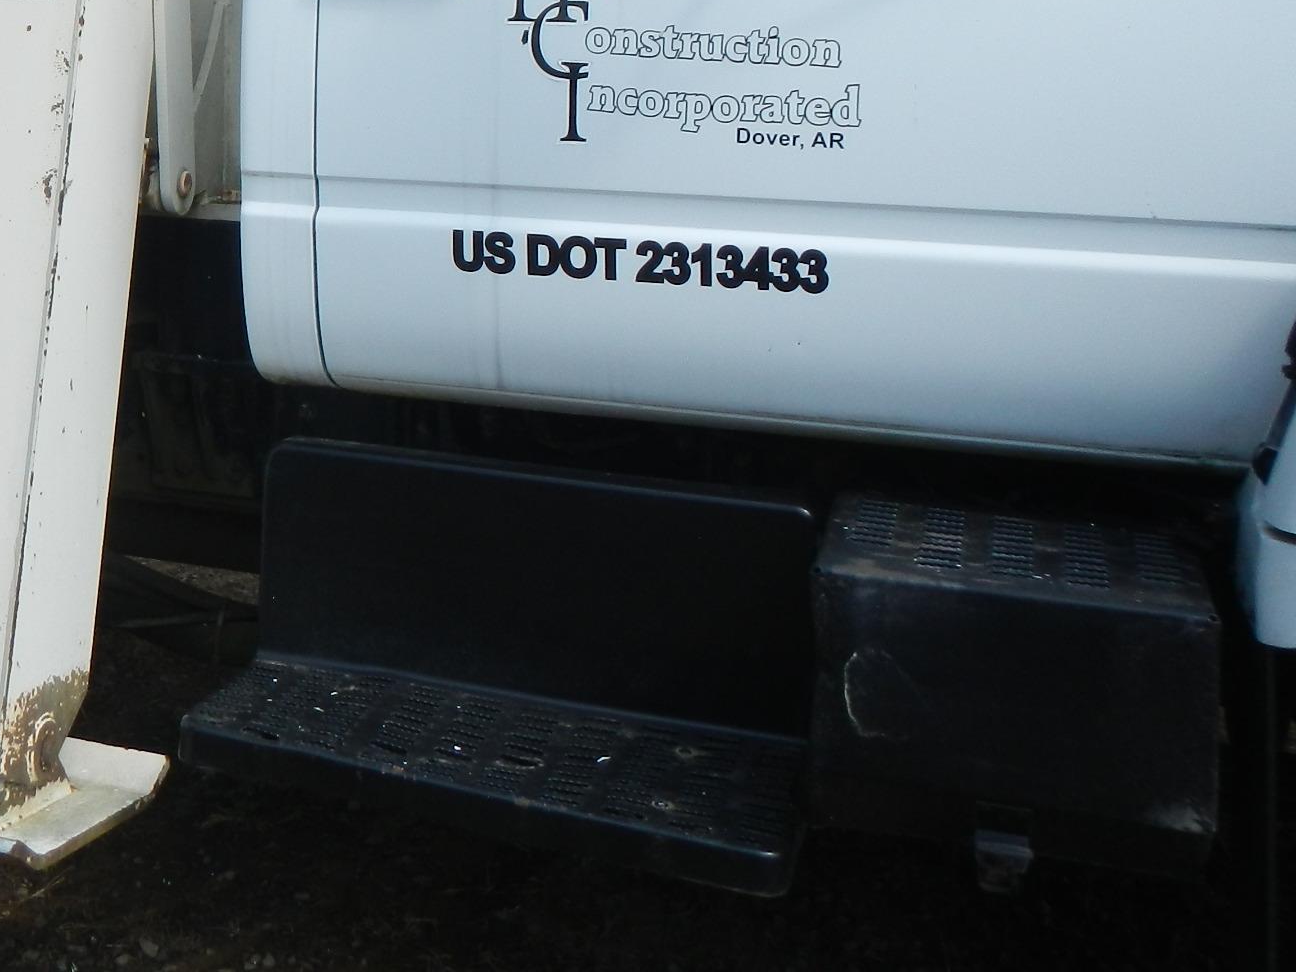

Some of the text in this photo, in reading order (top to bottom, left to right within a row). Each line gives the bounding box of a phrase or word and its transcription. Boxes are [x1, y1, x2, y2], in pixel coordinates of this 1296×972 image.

[530, 0, 842, 80] Construction
[559, 61, 862, 142] Incorporated
[736, 128, 845, 150] Dover, AR
[452, 229, 830, 295] US DOT 2313433
